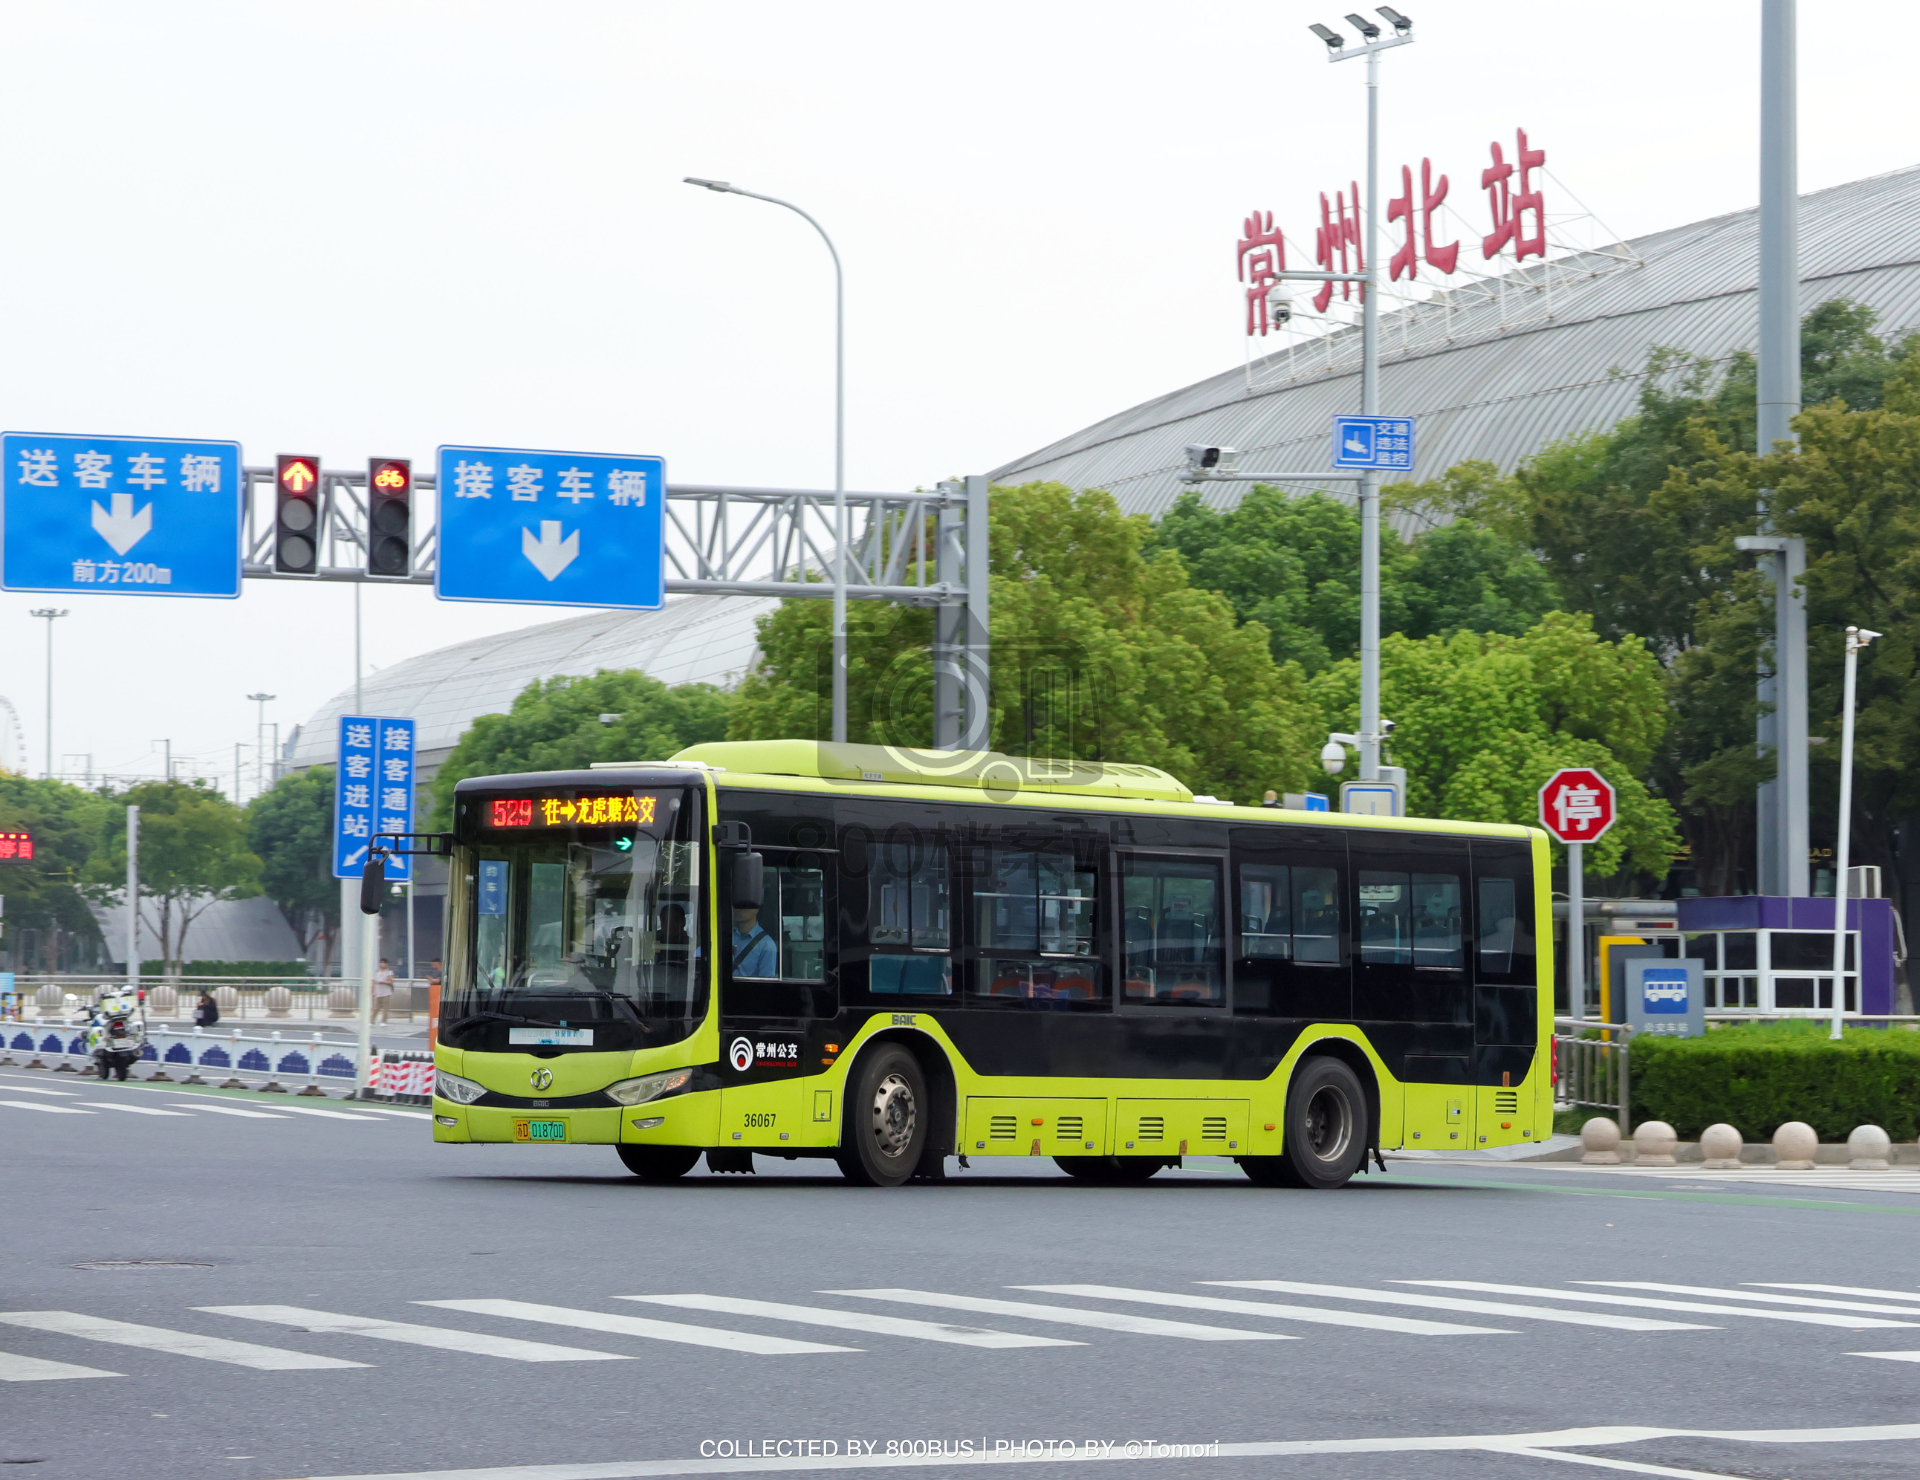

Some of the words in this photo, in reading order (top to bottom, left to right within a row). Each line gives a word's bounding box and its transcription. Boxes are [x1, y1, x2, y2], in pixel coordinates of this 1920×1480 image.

[1237, 127, 1546, 337] 常州北站
[1375, 422, 1409, 436] 交通
[1375, 437, 1409, 451] 违法
[17, 449, 222, 493] 送客车辆
[1375, 451, 1409, 465] 监控
[454, 460, 647, 507] 接客车辆
[71, 559, 172, 584] 前方200m
[341, 724, 372, 838] 送客进站
[380, 727, 411, 841] 接客通道
[493, 799, 533, 826] 529
[576, 796, 656, 824] 龙虎塘公交
[1552, 783, 1602, 832] 停
[892, 1014, 917, 1026] BAIC
[755, 1042, 798, 1059] 常州公交
[744, 1114, 776, 1127] 36067
